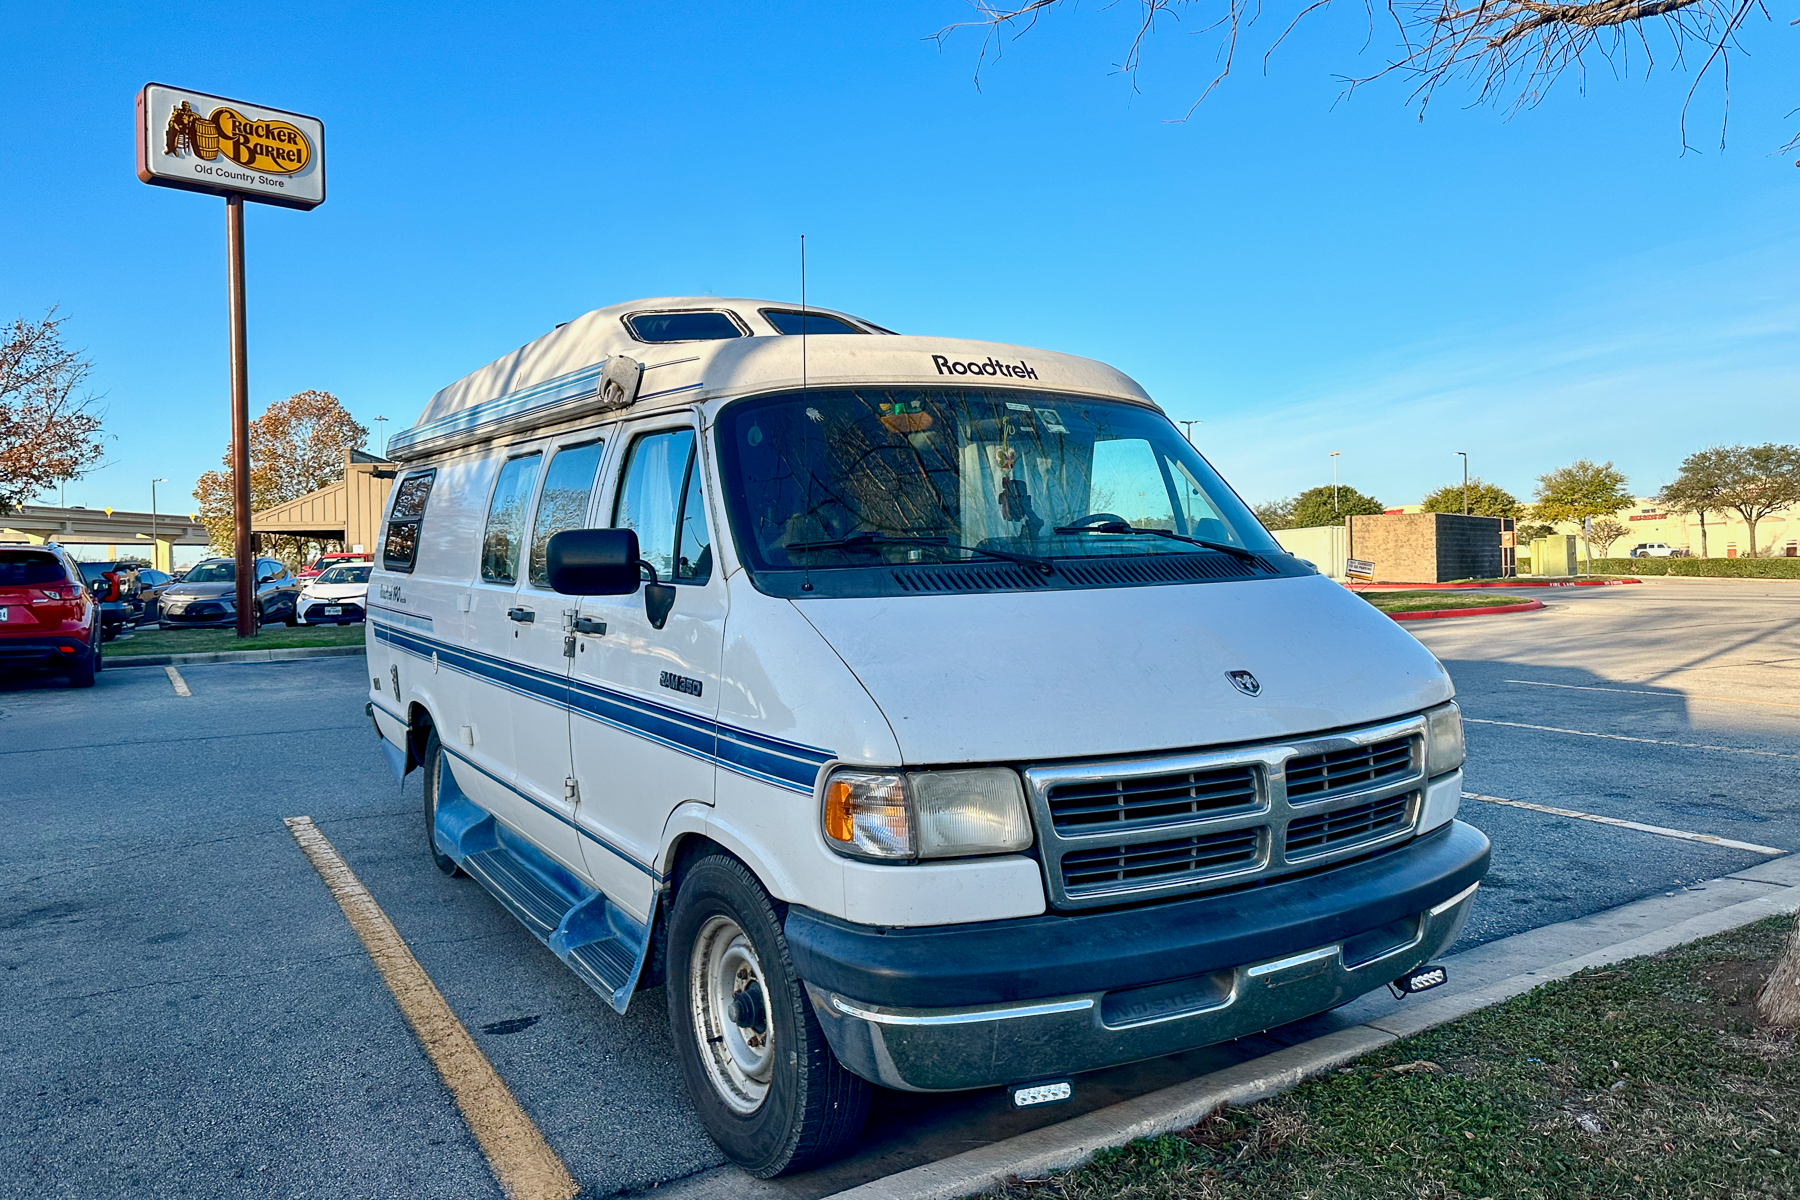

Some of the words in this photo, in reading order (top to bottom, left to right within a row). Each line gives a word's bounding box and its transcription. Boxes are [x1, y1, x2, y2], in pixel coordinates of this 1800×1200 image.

[213, 107, 299, 146] Cracker
[232, 132, 302, 171] Barrel
[195, 164, 213, 175] Old
[216, 168, 256, 184] Country
[258, 175, 285, 188] Store
[931, 355, 1039, 380] Roadtrek
[660, 670, 679, 690] RAM
[679, 677, 702, 697] 350
